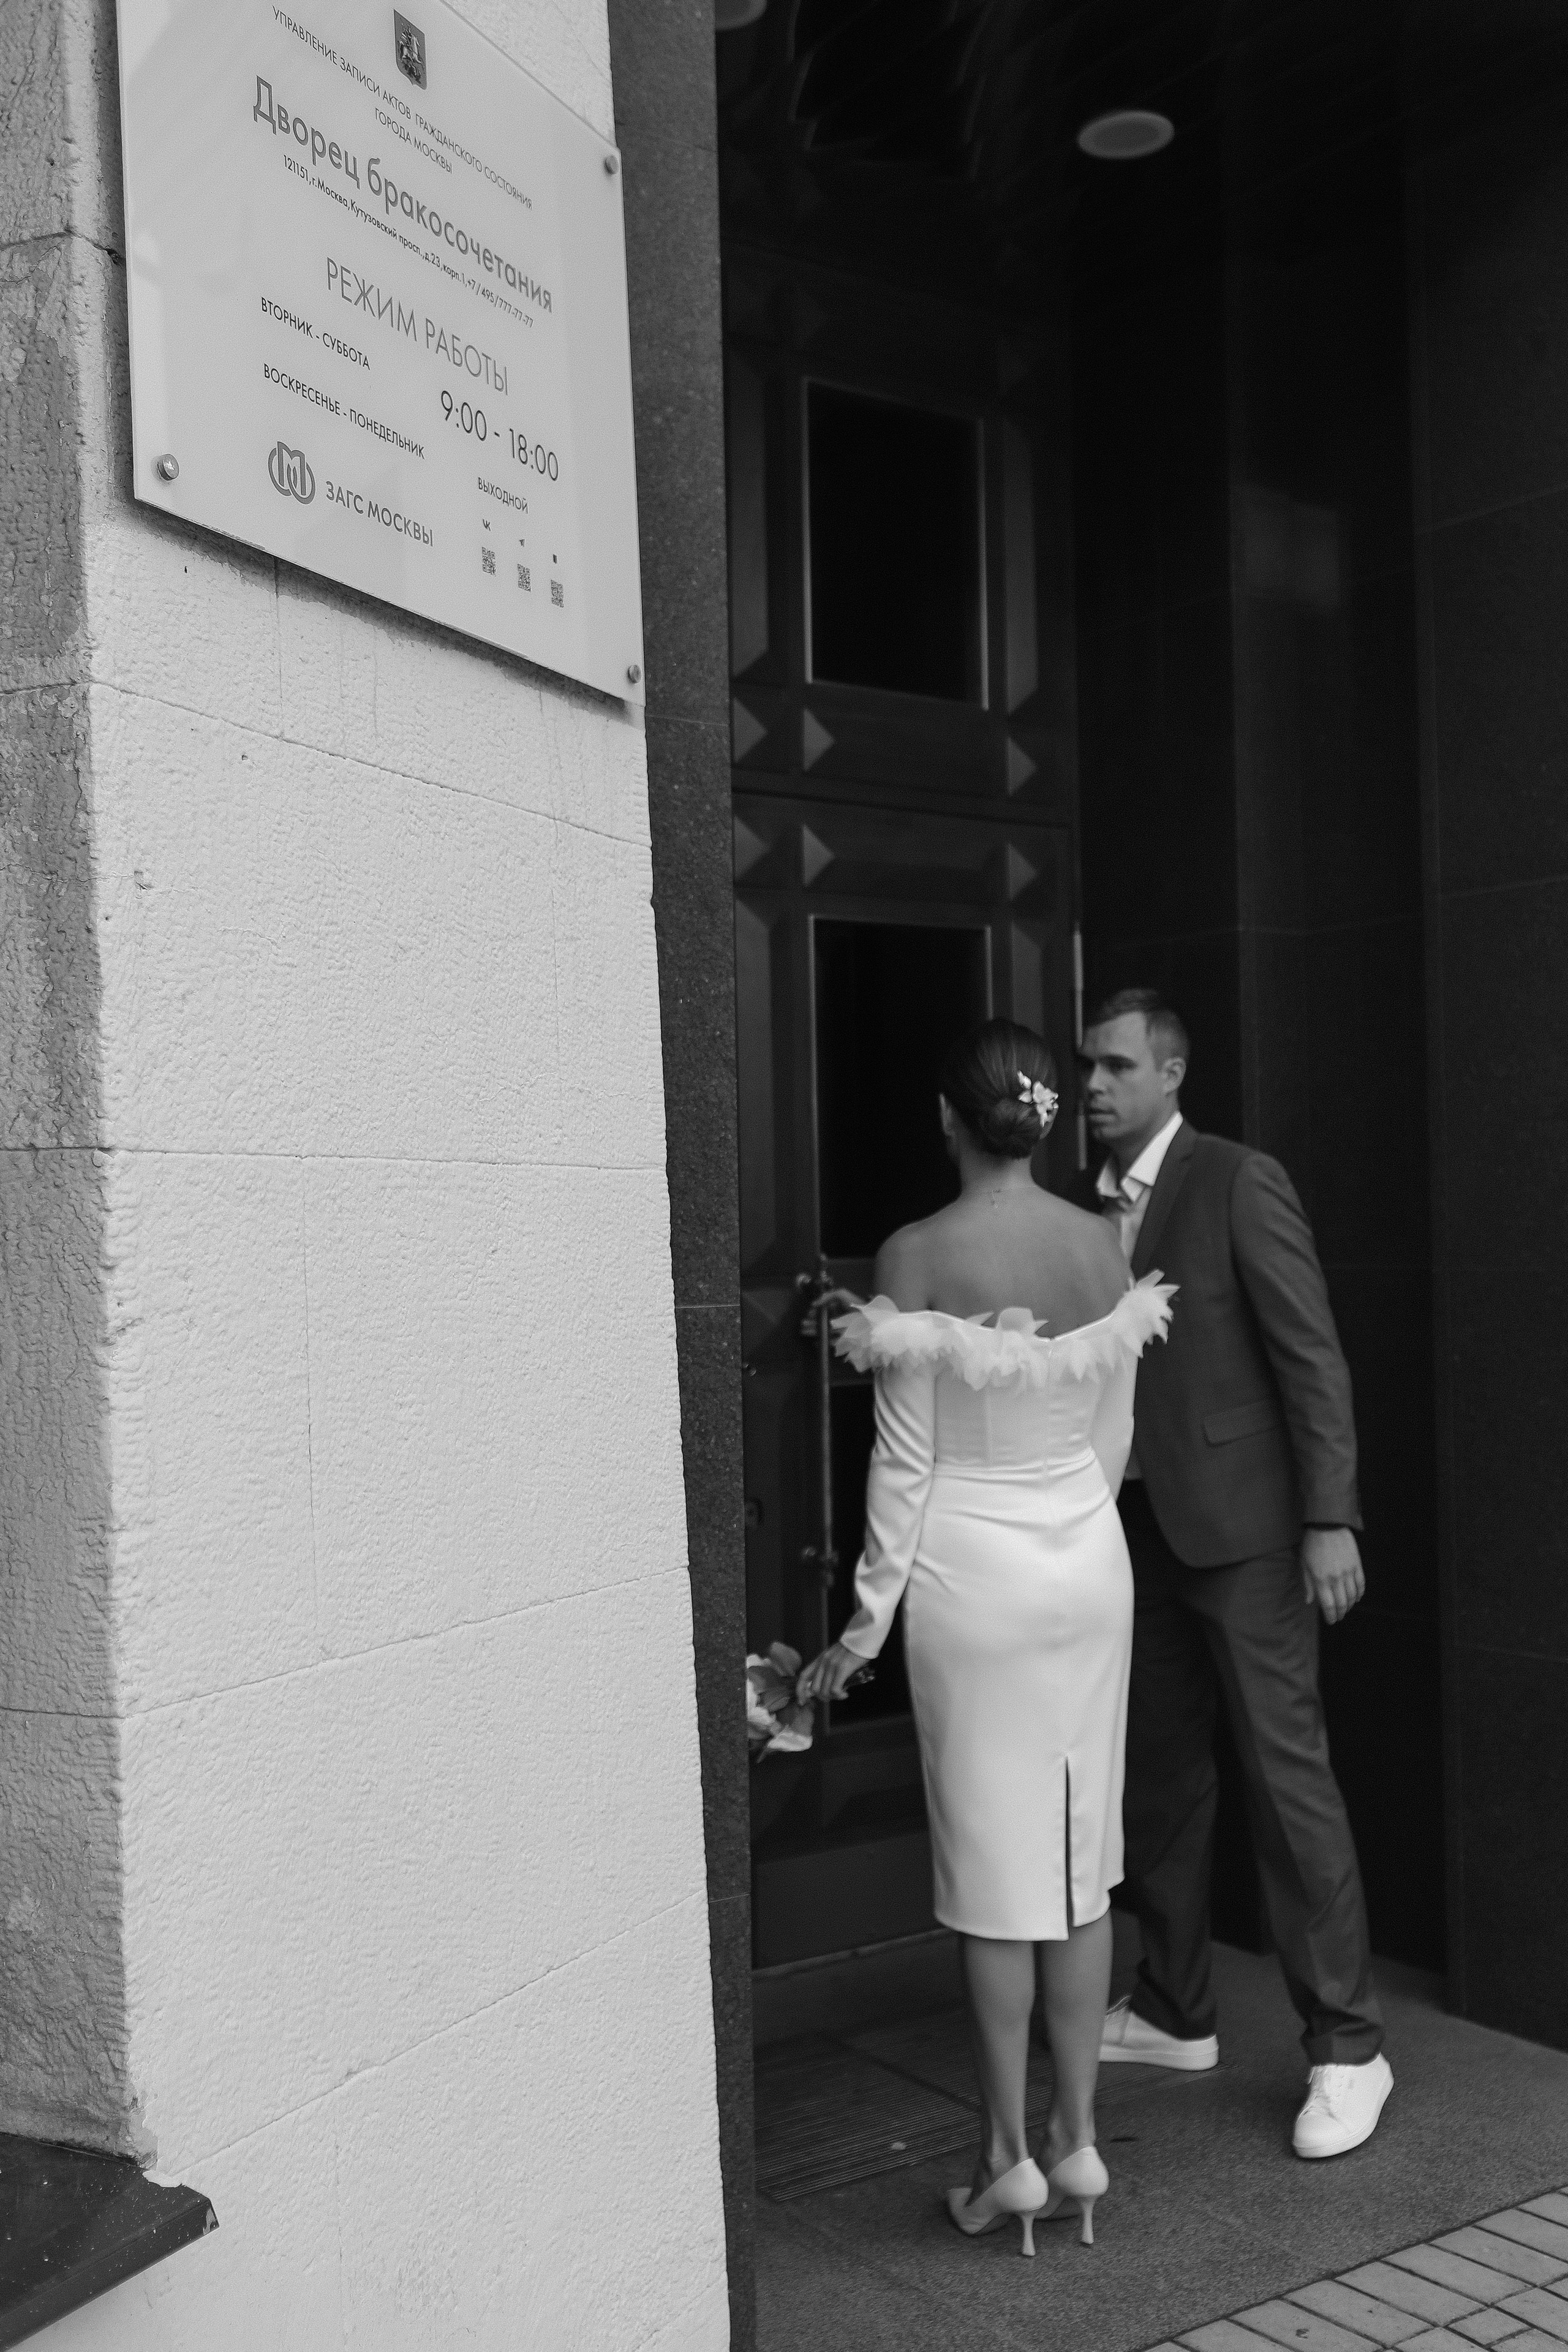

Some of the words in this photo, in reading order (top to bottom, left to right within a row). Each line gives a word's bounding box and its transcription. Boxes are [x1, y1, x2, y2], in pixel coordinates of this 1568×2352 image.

[273, 5, 337, 66] УПРАВЛЕНИЕ
[340, 57, 380, 97] ЗАПИСИ
[383, 90, 411, 119] АКТОВ
[415, 113, 483, 172] ГРАЖДАНСКОГО
[484, 167, 532, 209] СОСТОЯНИЯ
[375, 107, 412, 145] ГОРОДА
[414, 137, 453, 174] МОСКВЫ
[253, 75, 360, 190] Дворец
[368, 157, 552, 313] бракосочетания
[262, 296, 314, 339] ВТОРНИК
[322, 333, 370, 371] СУББОТА
[327, 257, 417, 342] РЕЖИМ
[426, 317, 508, 395] РАБОТЫ
[264, 363, 341, 416] ВОСКРЕСЕНЬЕ
[350, 409, 424, 460] ПОНЕДЕЛЬНИК
[441, 390, 487, 442] 9:00
[510, 428, 559, 481] 18:00
[325, 481, 364, 514] ЗАГС
[368, 500, 434, 547] МОСКВЫ
[478, 477, 528, 514] ВЫХОДНОЙ
